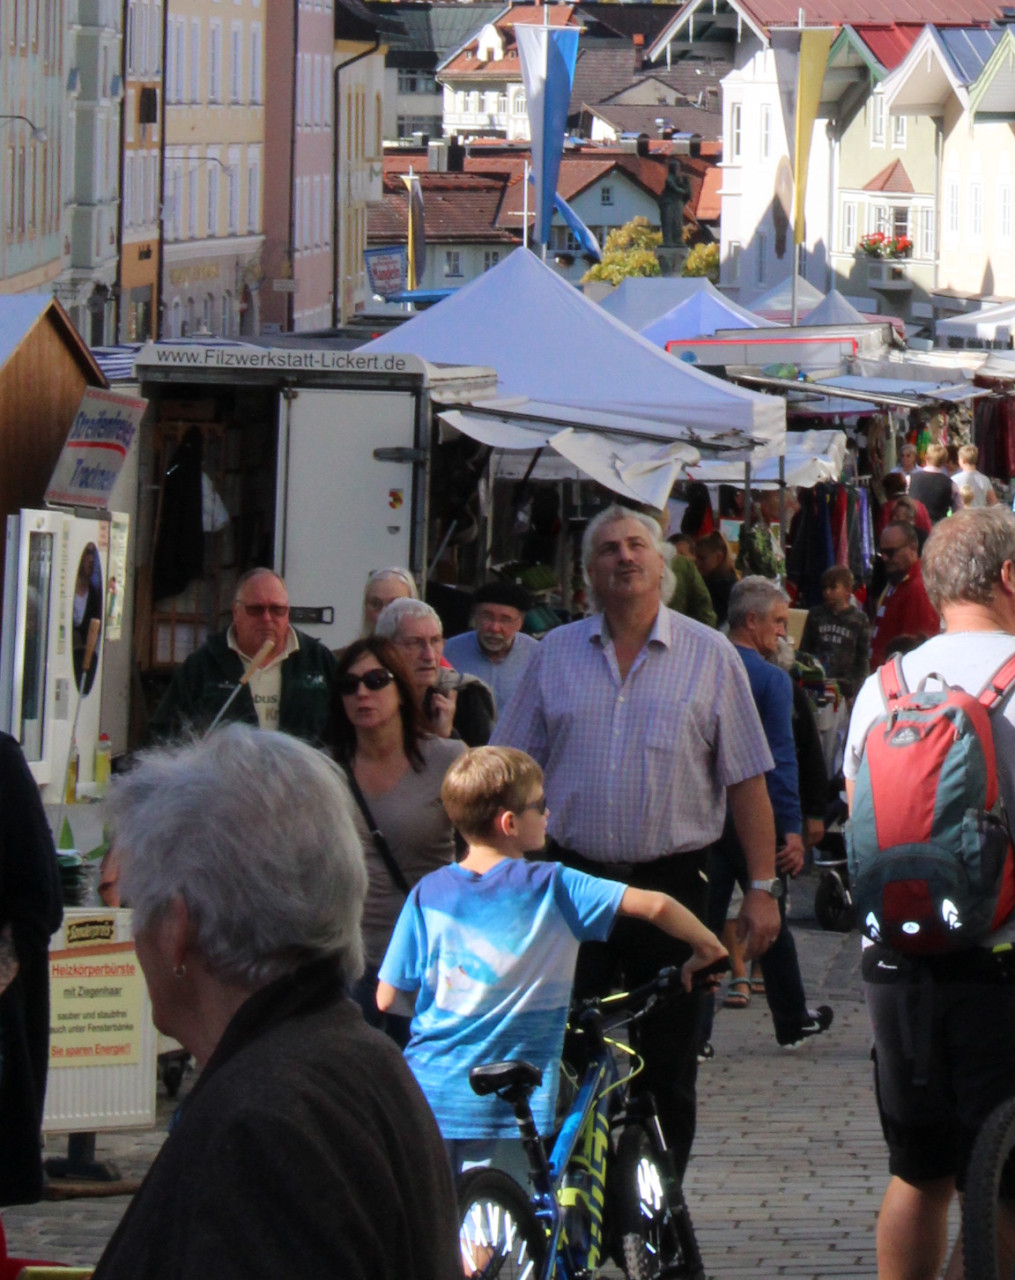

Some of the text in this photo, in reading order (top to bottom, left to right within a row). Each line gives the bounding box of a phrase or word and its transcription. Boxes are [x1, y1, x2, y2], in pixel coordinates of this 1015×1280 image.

[156, 348, 406, 371] www.Filzwerkstatt-Lickert.de
[52, 963, 135, 978] Heizkörperbürste
[77, 986, 122, 998] Ziegenhaar
[82, 1011, 95, 1019] und
